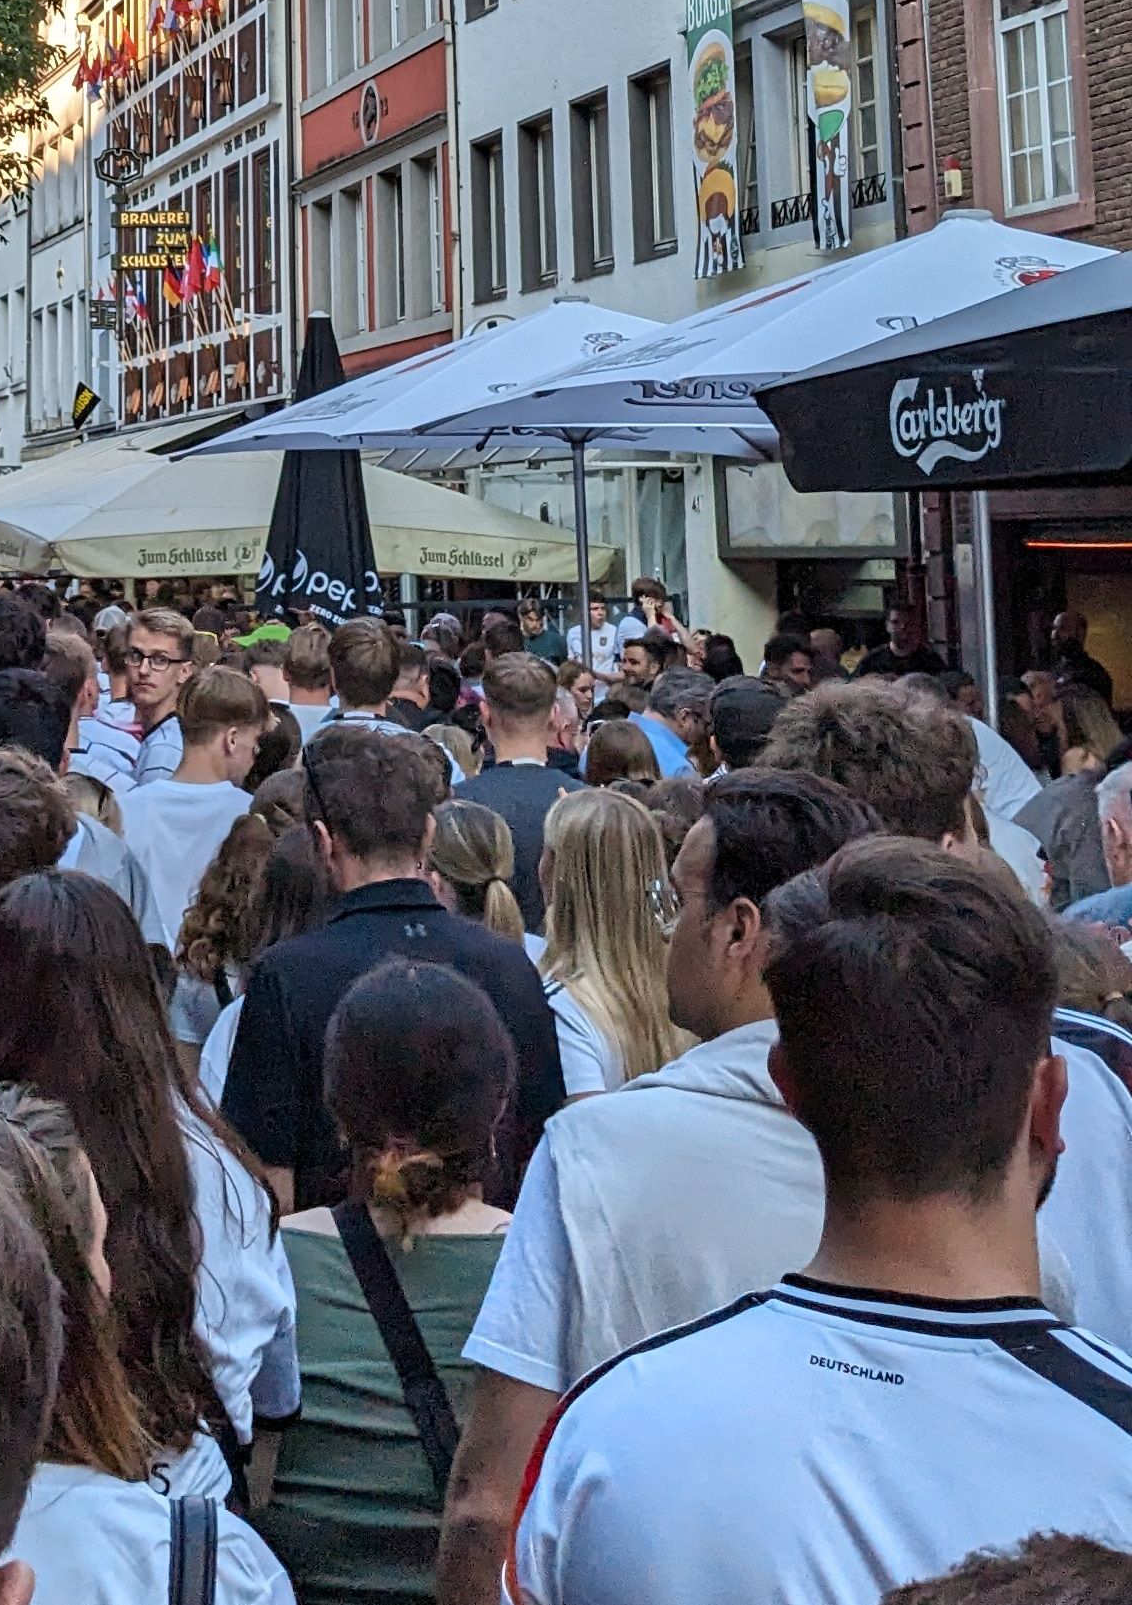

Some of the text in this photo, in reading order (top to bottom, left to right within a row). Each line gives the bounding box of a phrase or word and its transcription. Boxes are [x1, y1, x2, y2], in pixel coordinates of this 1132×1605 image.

[121, 212, 190, 225] BRAUEREI
[156, 233, 187, 245] ZUM
[890, 376, 1002, 460] Carlsberg
[138, 546, 228, 567] Zum Schlüssel
[420, 547, 504, 568] Zum Schlüssel
[306, 571, 356, 612] pep
[309, 603, 333, 619] ZERO
[810, 1355, 905, 1385] DEUTSCHLAND
